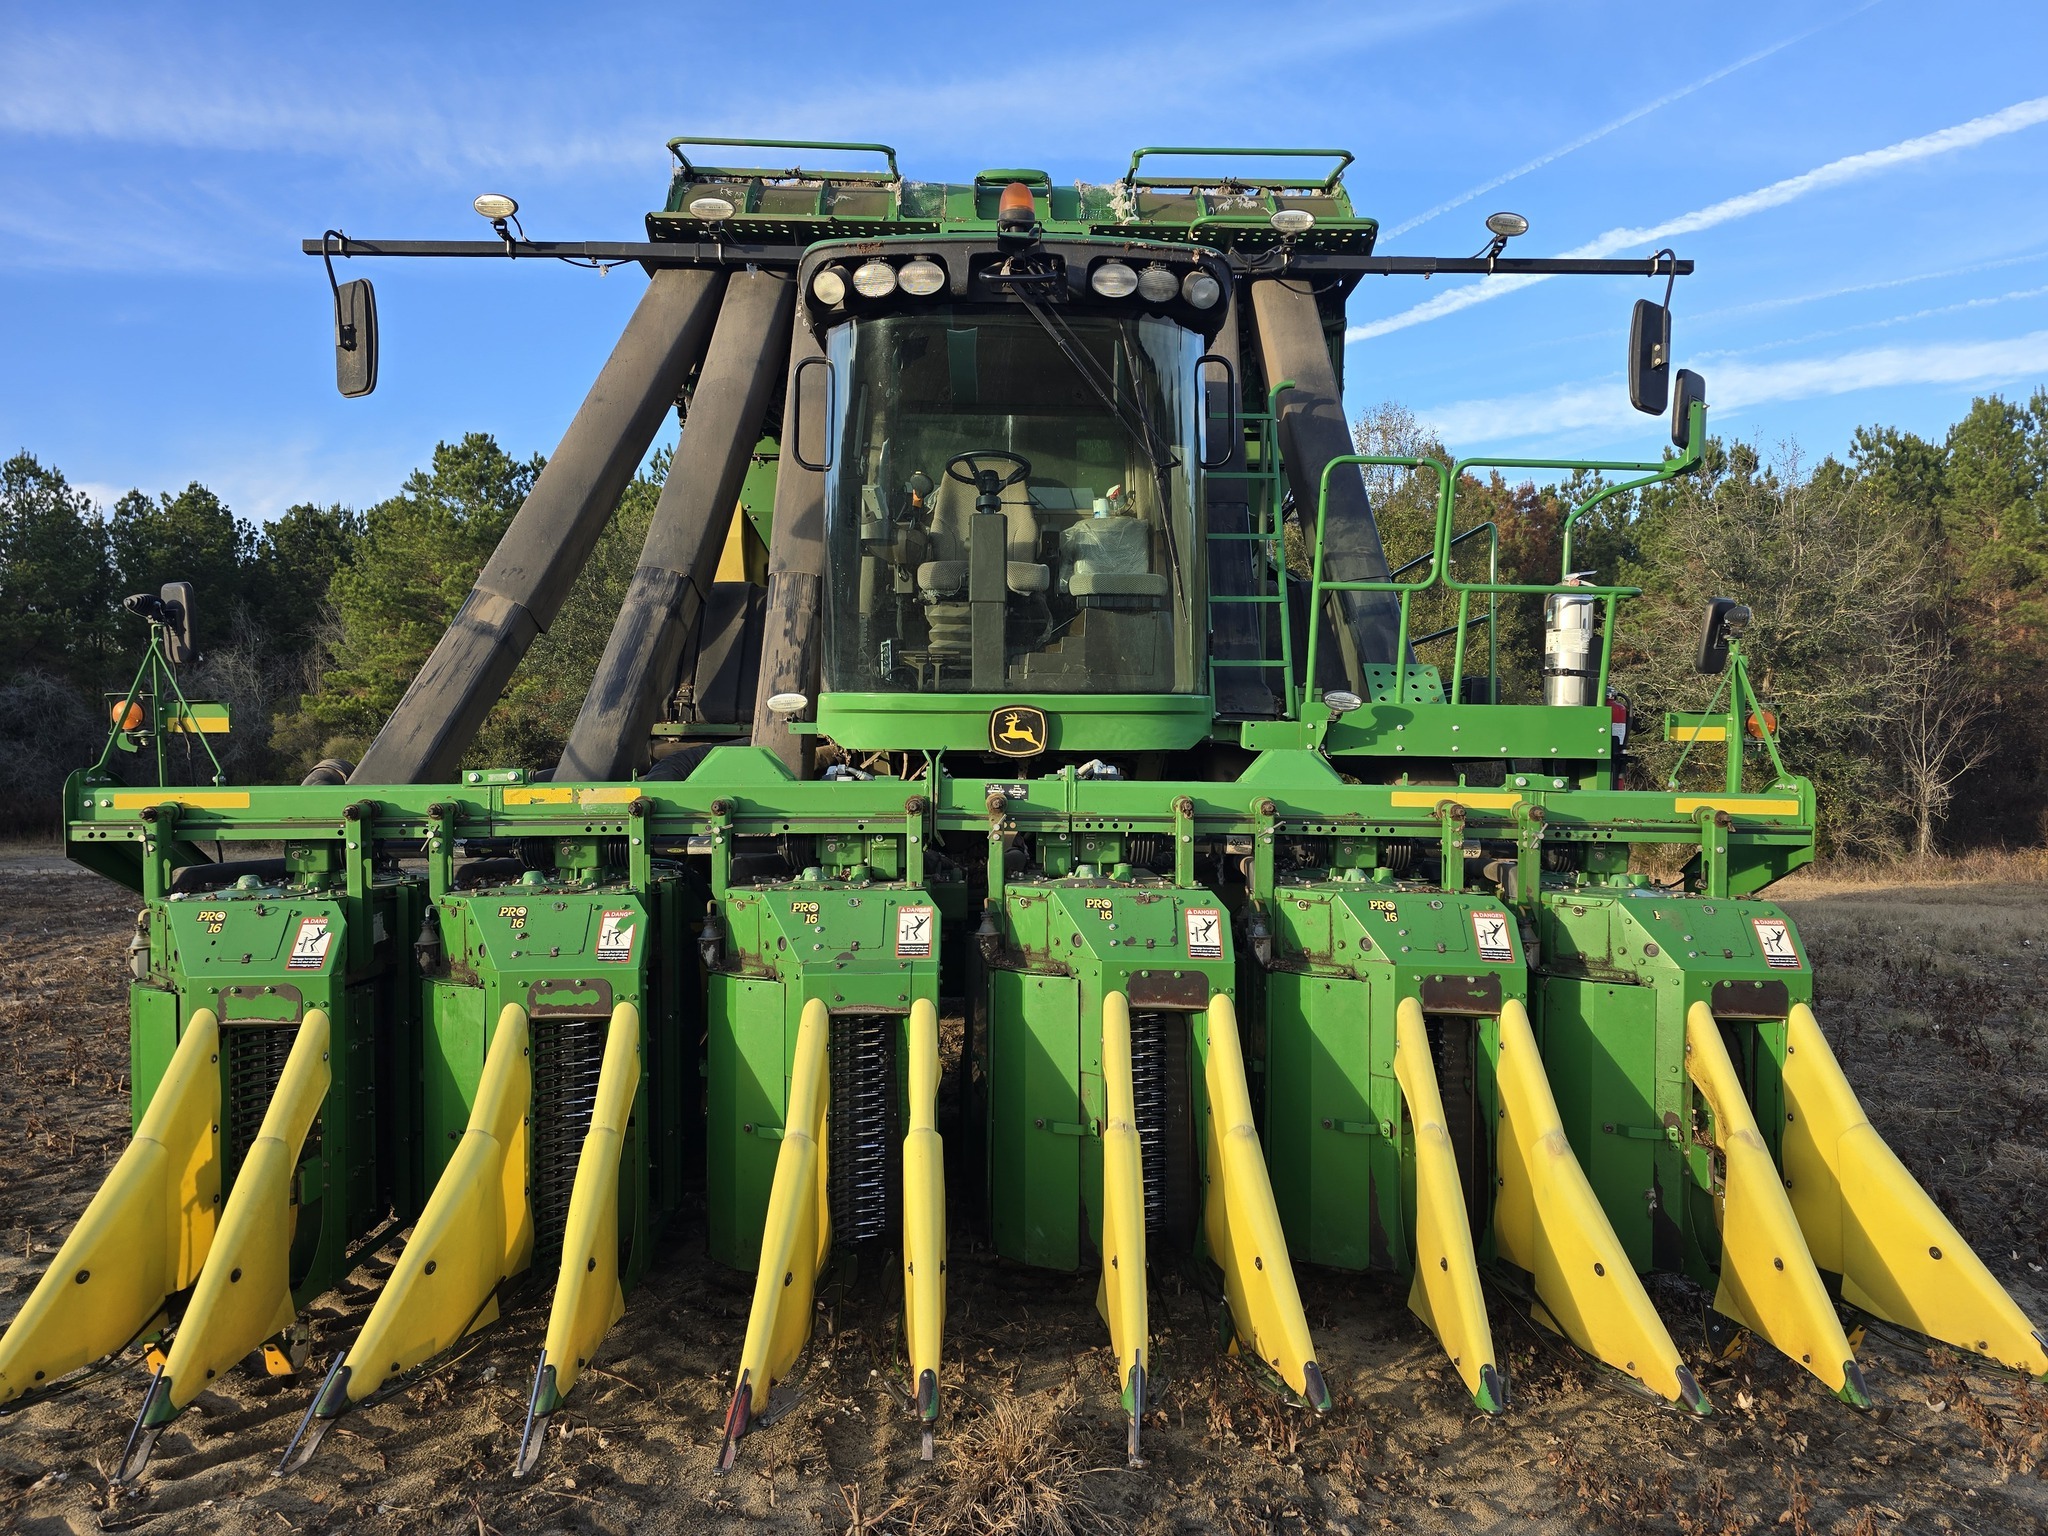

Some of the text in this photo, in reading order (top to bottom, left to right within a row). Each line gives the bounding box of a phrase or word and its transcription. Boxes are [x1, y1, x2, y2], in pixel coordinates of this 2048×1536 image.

[792, 902, 819, 912] PRO
[1086, 898, 1112, 908] PRO
[1370, 900, 1395, 911] PRO
[196, 911, 226, 921] PRO
[499, 906, 527, 917] PRO
[1100, 910, 1113, 920] 16
[805, 914, 818, 924] 16
[1385, 912, 1398, 922] 16
[207, 923, 222, 934] 16
[511, 918, 525, 929] 16
